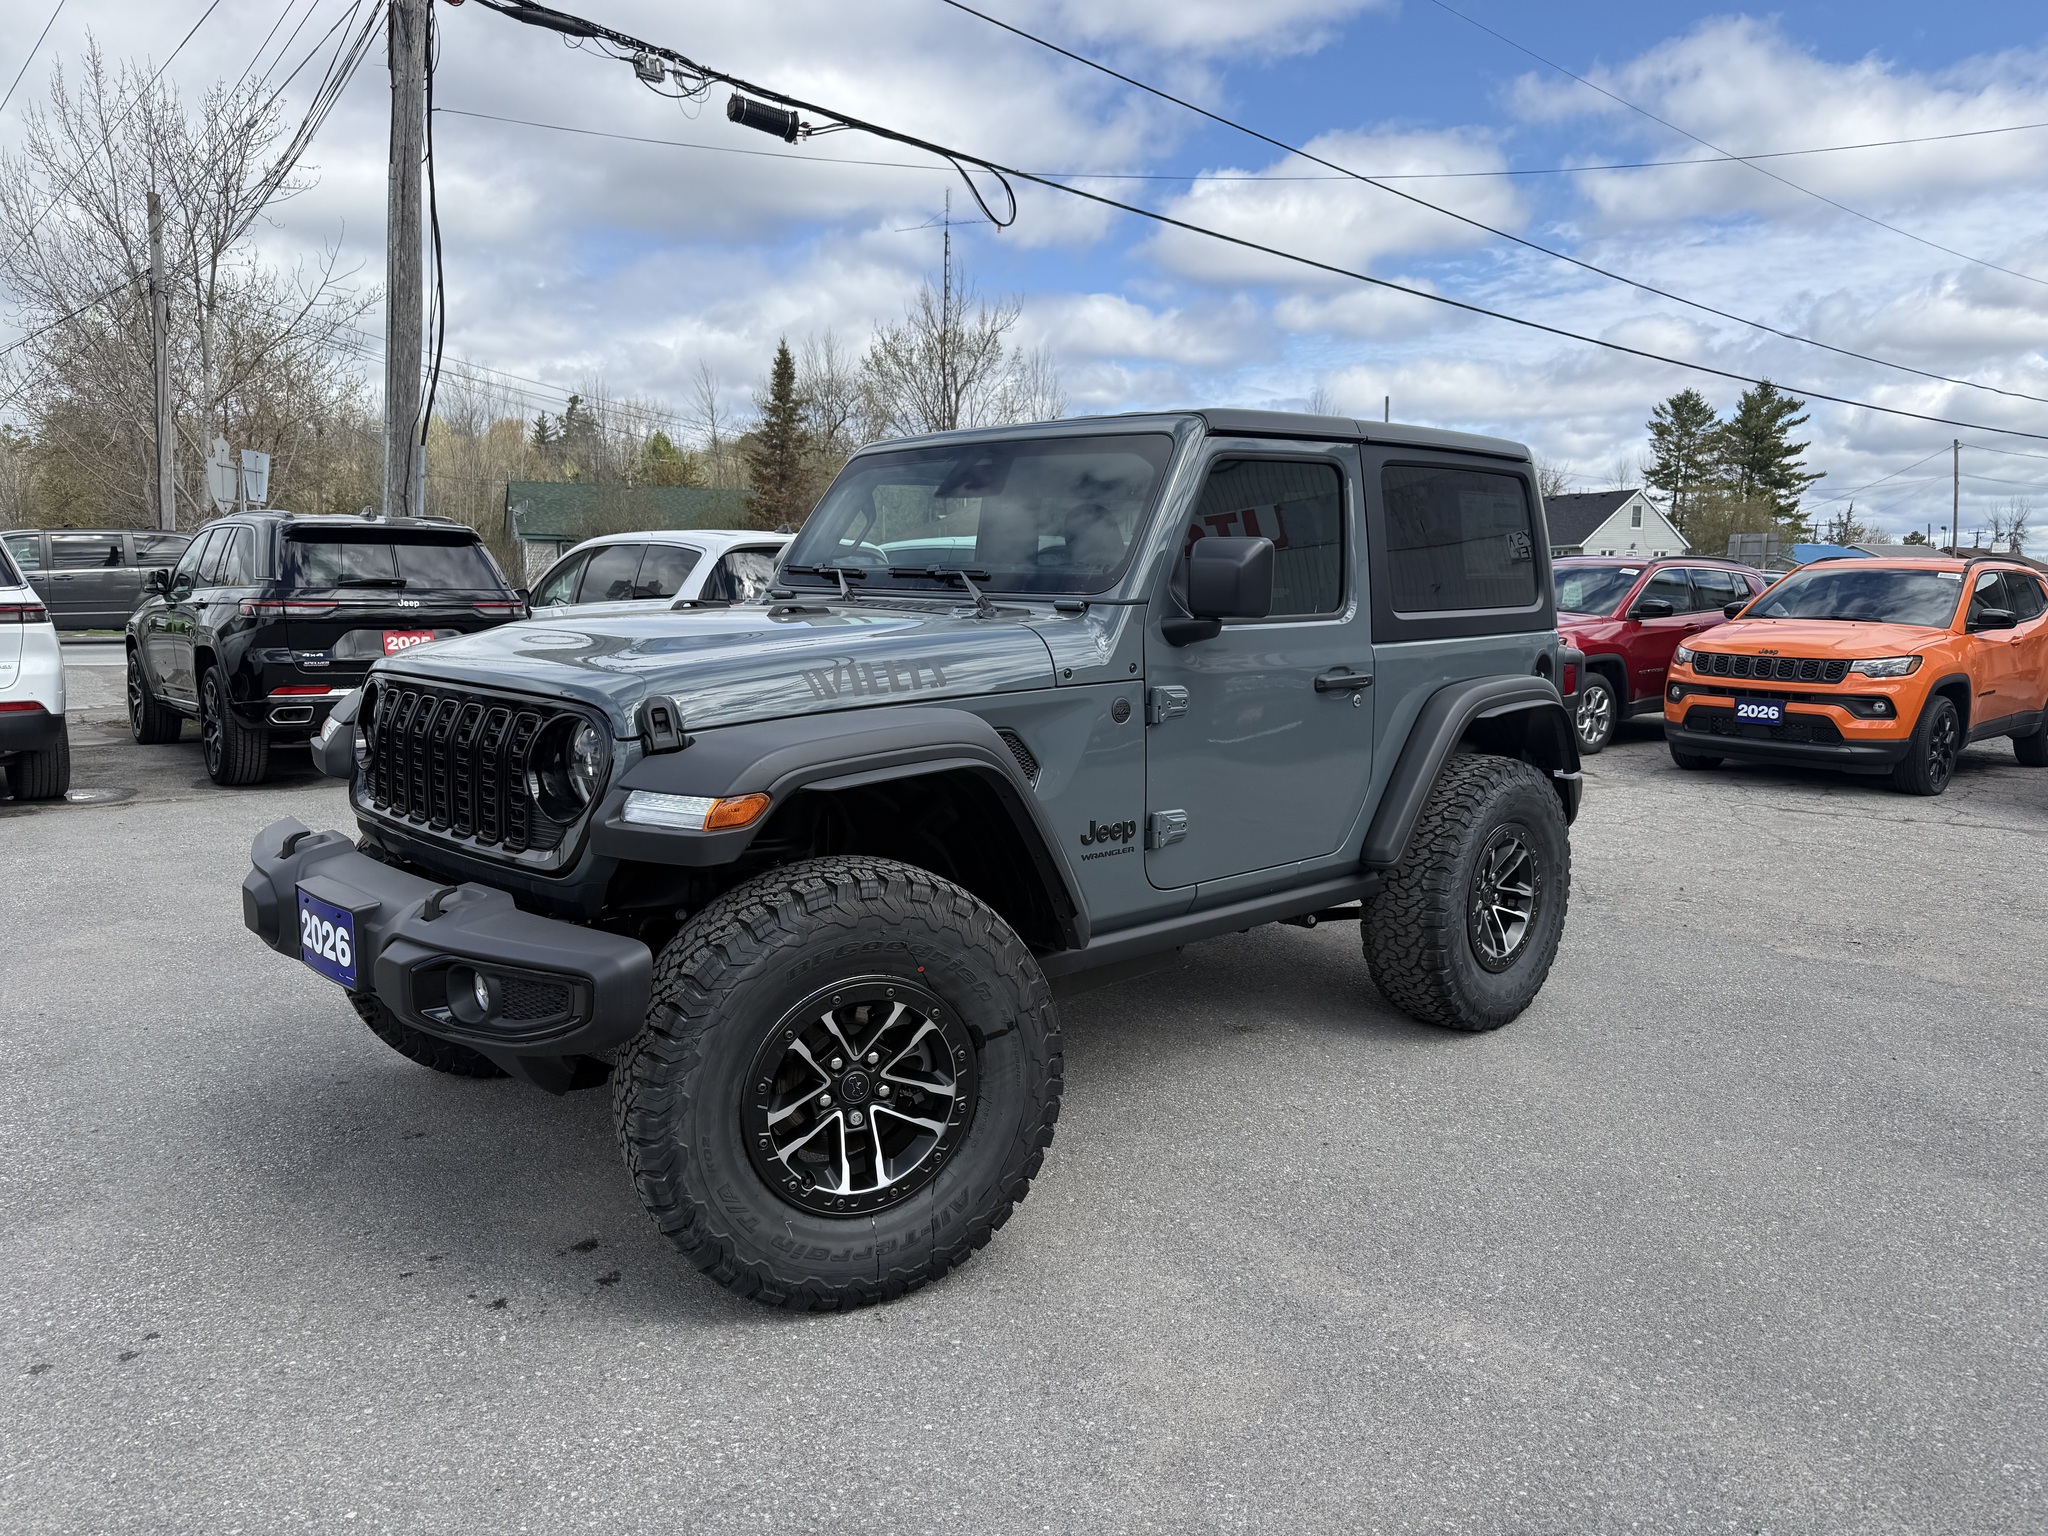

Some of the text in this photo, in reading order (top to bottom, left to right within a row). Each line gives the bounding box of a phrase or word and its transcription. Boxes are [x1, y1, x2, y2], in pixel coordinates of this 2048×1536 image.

[397, 599, 420, 608] Jeep
[1737, 704, 1779, 719] 2026
[1080, 819, 1137, 846] Jeep
[1081, 846, 1135, 861] WRANGLER
[301, 908, 351, 967] 2026
[786, 939, 993, 1002] BFGoodrich
